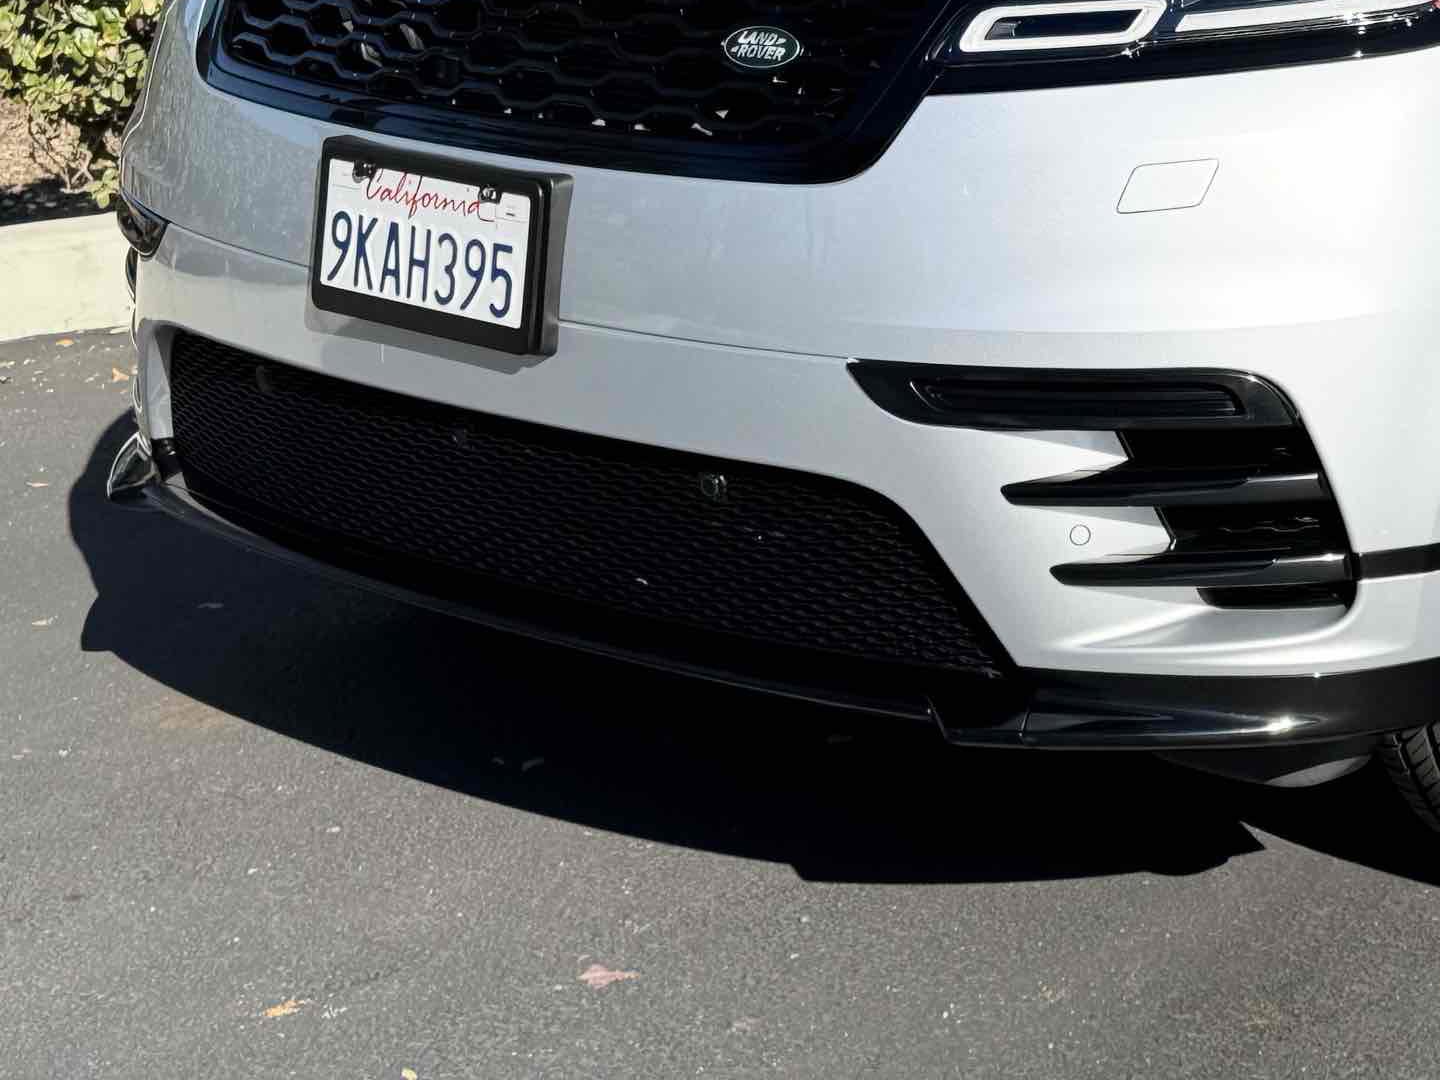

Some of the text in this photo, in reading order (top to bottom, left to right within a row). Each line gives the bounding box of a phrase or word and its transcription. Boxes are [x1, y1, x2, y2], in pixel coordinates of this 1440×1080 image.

[736, 44, 787, 61] ROVER
[737, 30, 779, 46] LAND
[364, 167, 495, 223] California
[327, 210, 514, 319] 9KAH395
